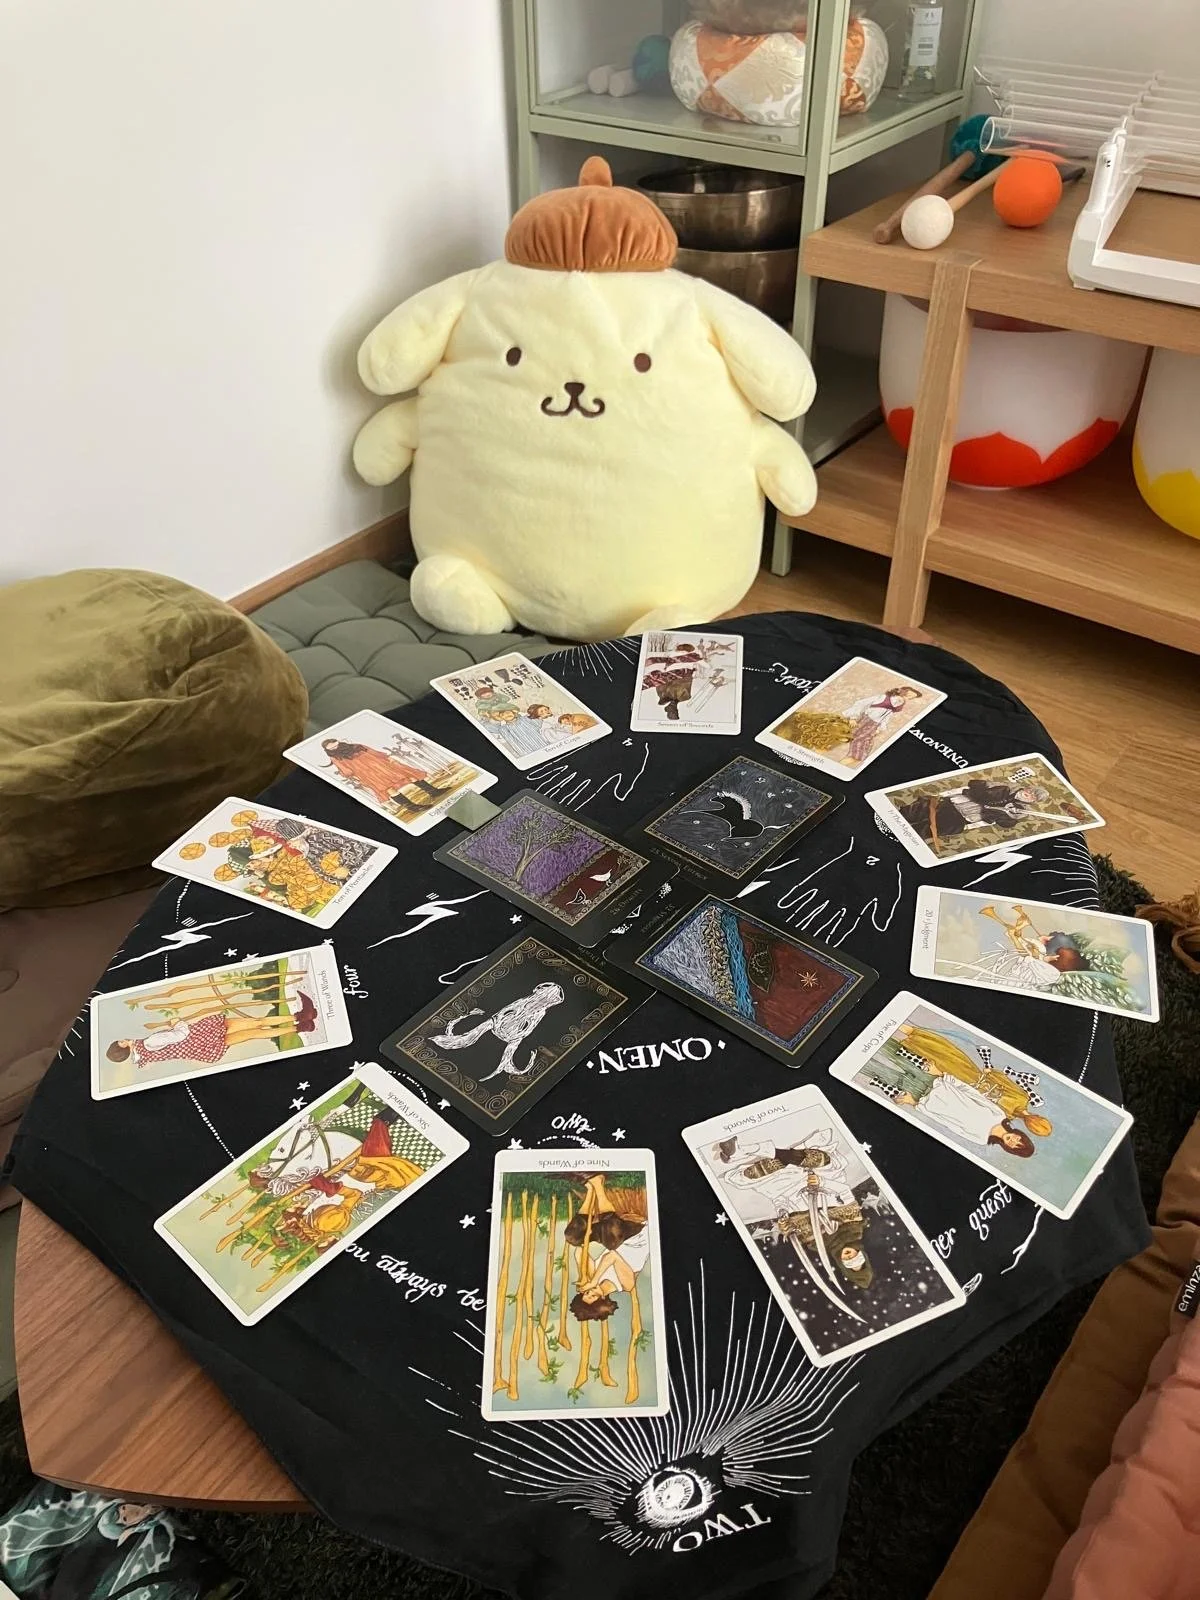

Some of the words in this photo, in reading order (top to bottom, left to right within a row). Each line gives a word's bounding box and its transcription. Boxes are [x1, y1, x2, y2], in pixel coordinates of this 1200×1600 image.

[907, 726, 969, 769] UNKNOW
[317, 970, 329, 993] Wands
[343, 964, 369, 998] four
[326, 1000, 336, 1020] Three
[884, 1019, 898, 1032] Five
[598, 1037, 712, 1074] OMEN
[862, 1038, 880, 1053] Cups
[386, 1092, 409, 1115] Wands
[767, 1105, 790, 1115] Two
[418, 1117, 430, 1130] Six
[551, 1112, 596, 1134] two
[723, 1115, 757, 1133] Swords
[757, 1111, 767, 1123] of
[538, 1160, 572, 1169] Wands
[572, 1160, 585, 1168] of
[586, 1160, 610, 1168] Nine
[969, 1178, 1012, 1241] quest
[456, 1288, 488, 1312] be
[672, 1503, 772, 1553] TWO
